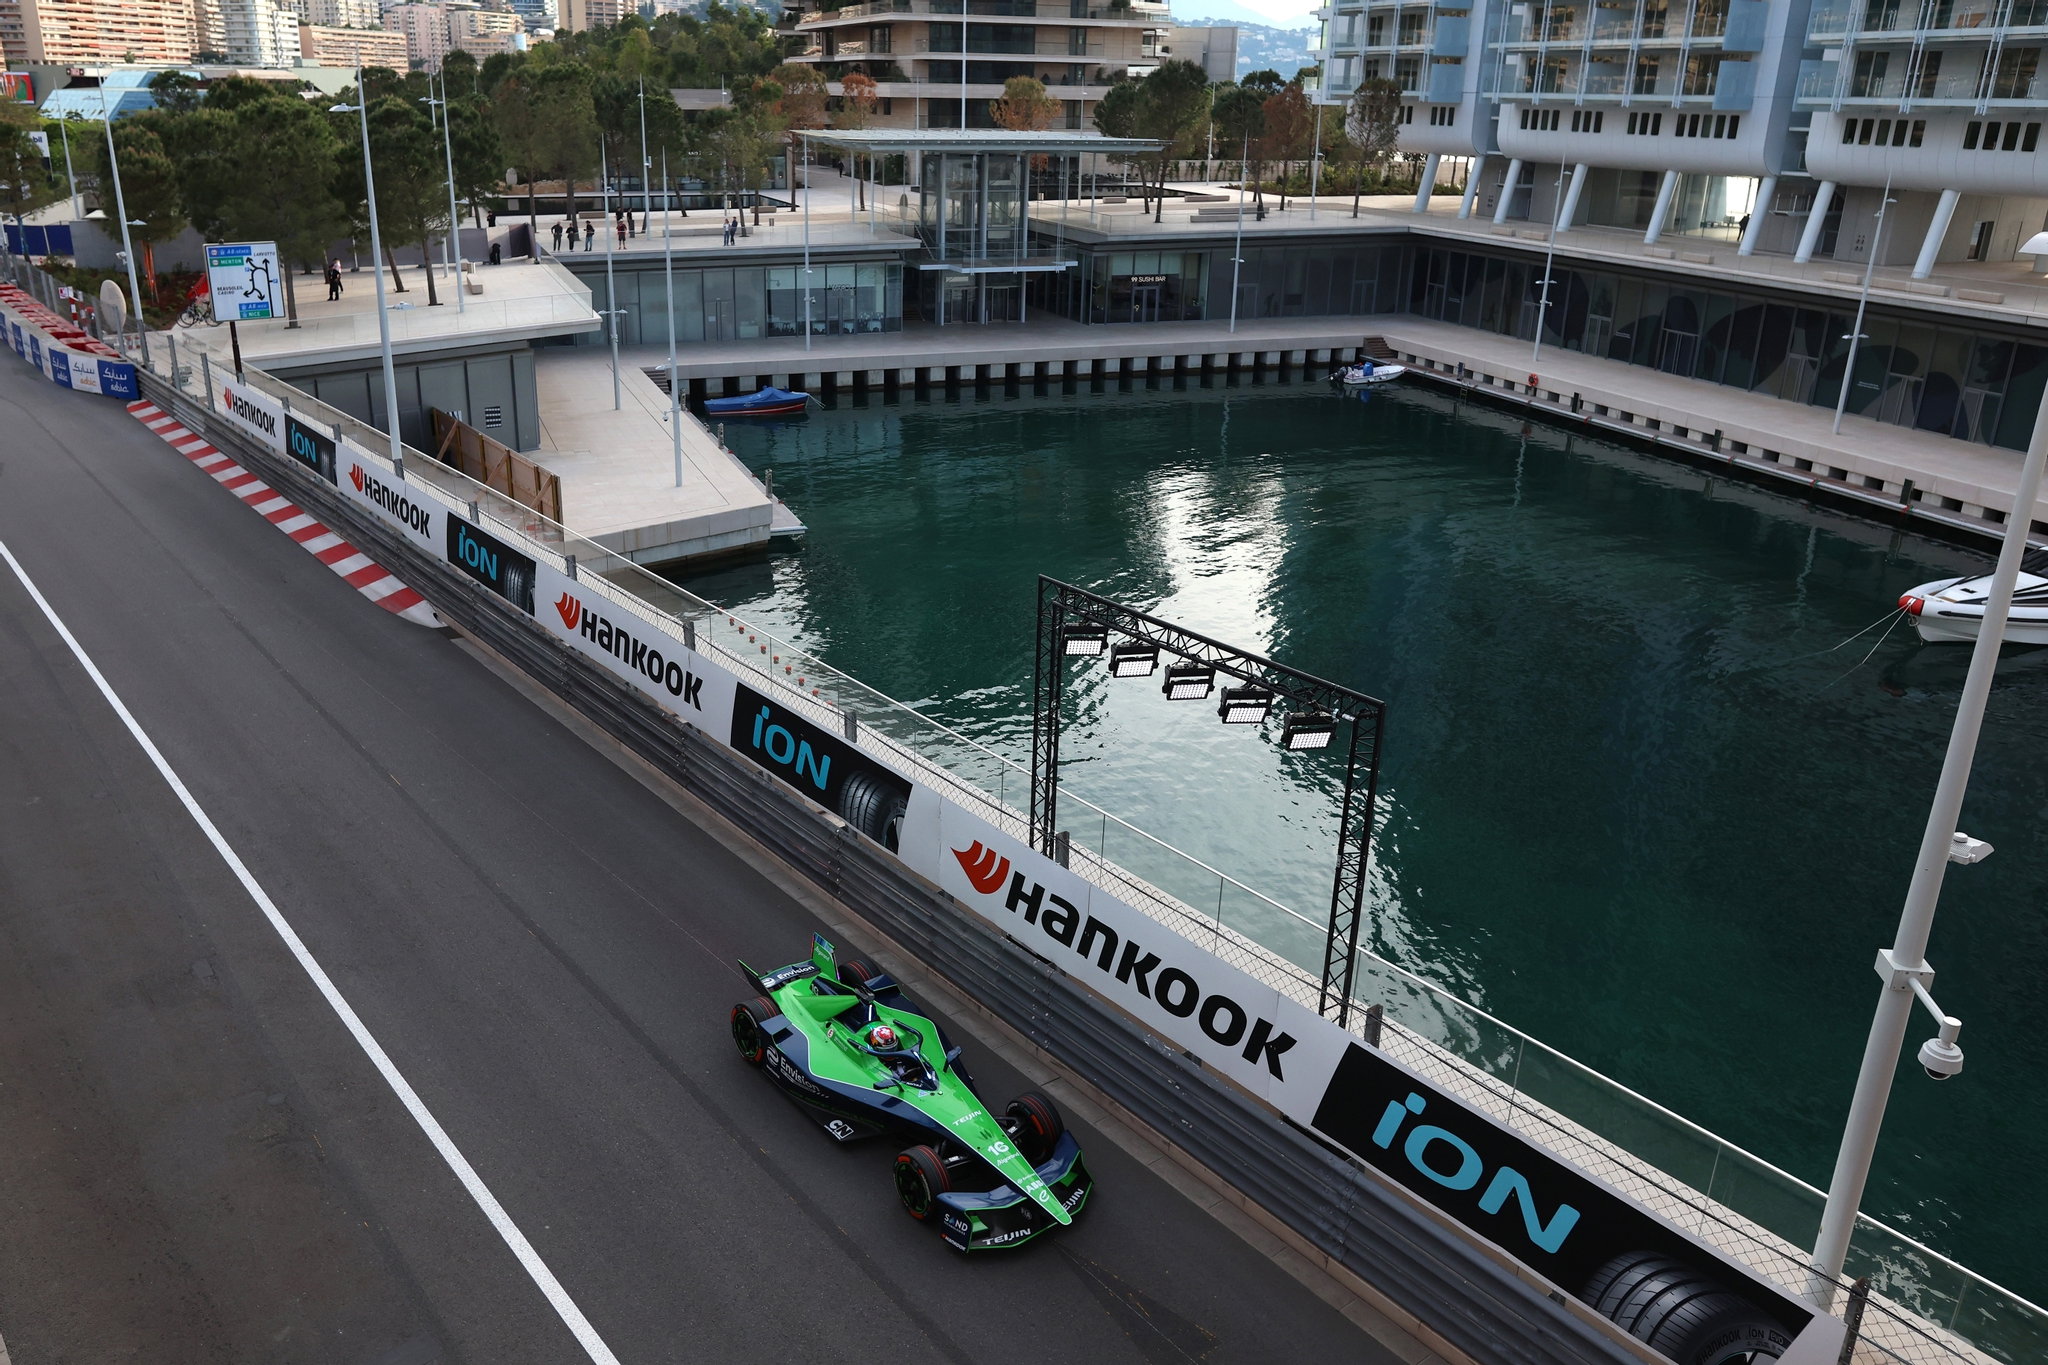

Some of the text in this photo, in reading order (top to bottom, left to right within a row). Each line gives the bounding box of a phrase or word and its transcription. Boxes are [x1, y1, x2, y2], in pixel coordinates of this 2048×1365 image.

[103, 367, 127, 382] سابك
[777, 965, 815, 980] Envision
[780, 1056, 820, 1092] Envision
[952, 1110, 982, 1126] TEIJIN
[988, 1141, 1010, 1156] 16
[1062, 1188, 1084, 1211] EIJIN
[982, 1228, 1031, 1246] TEIJIN
